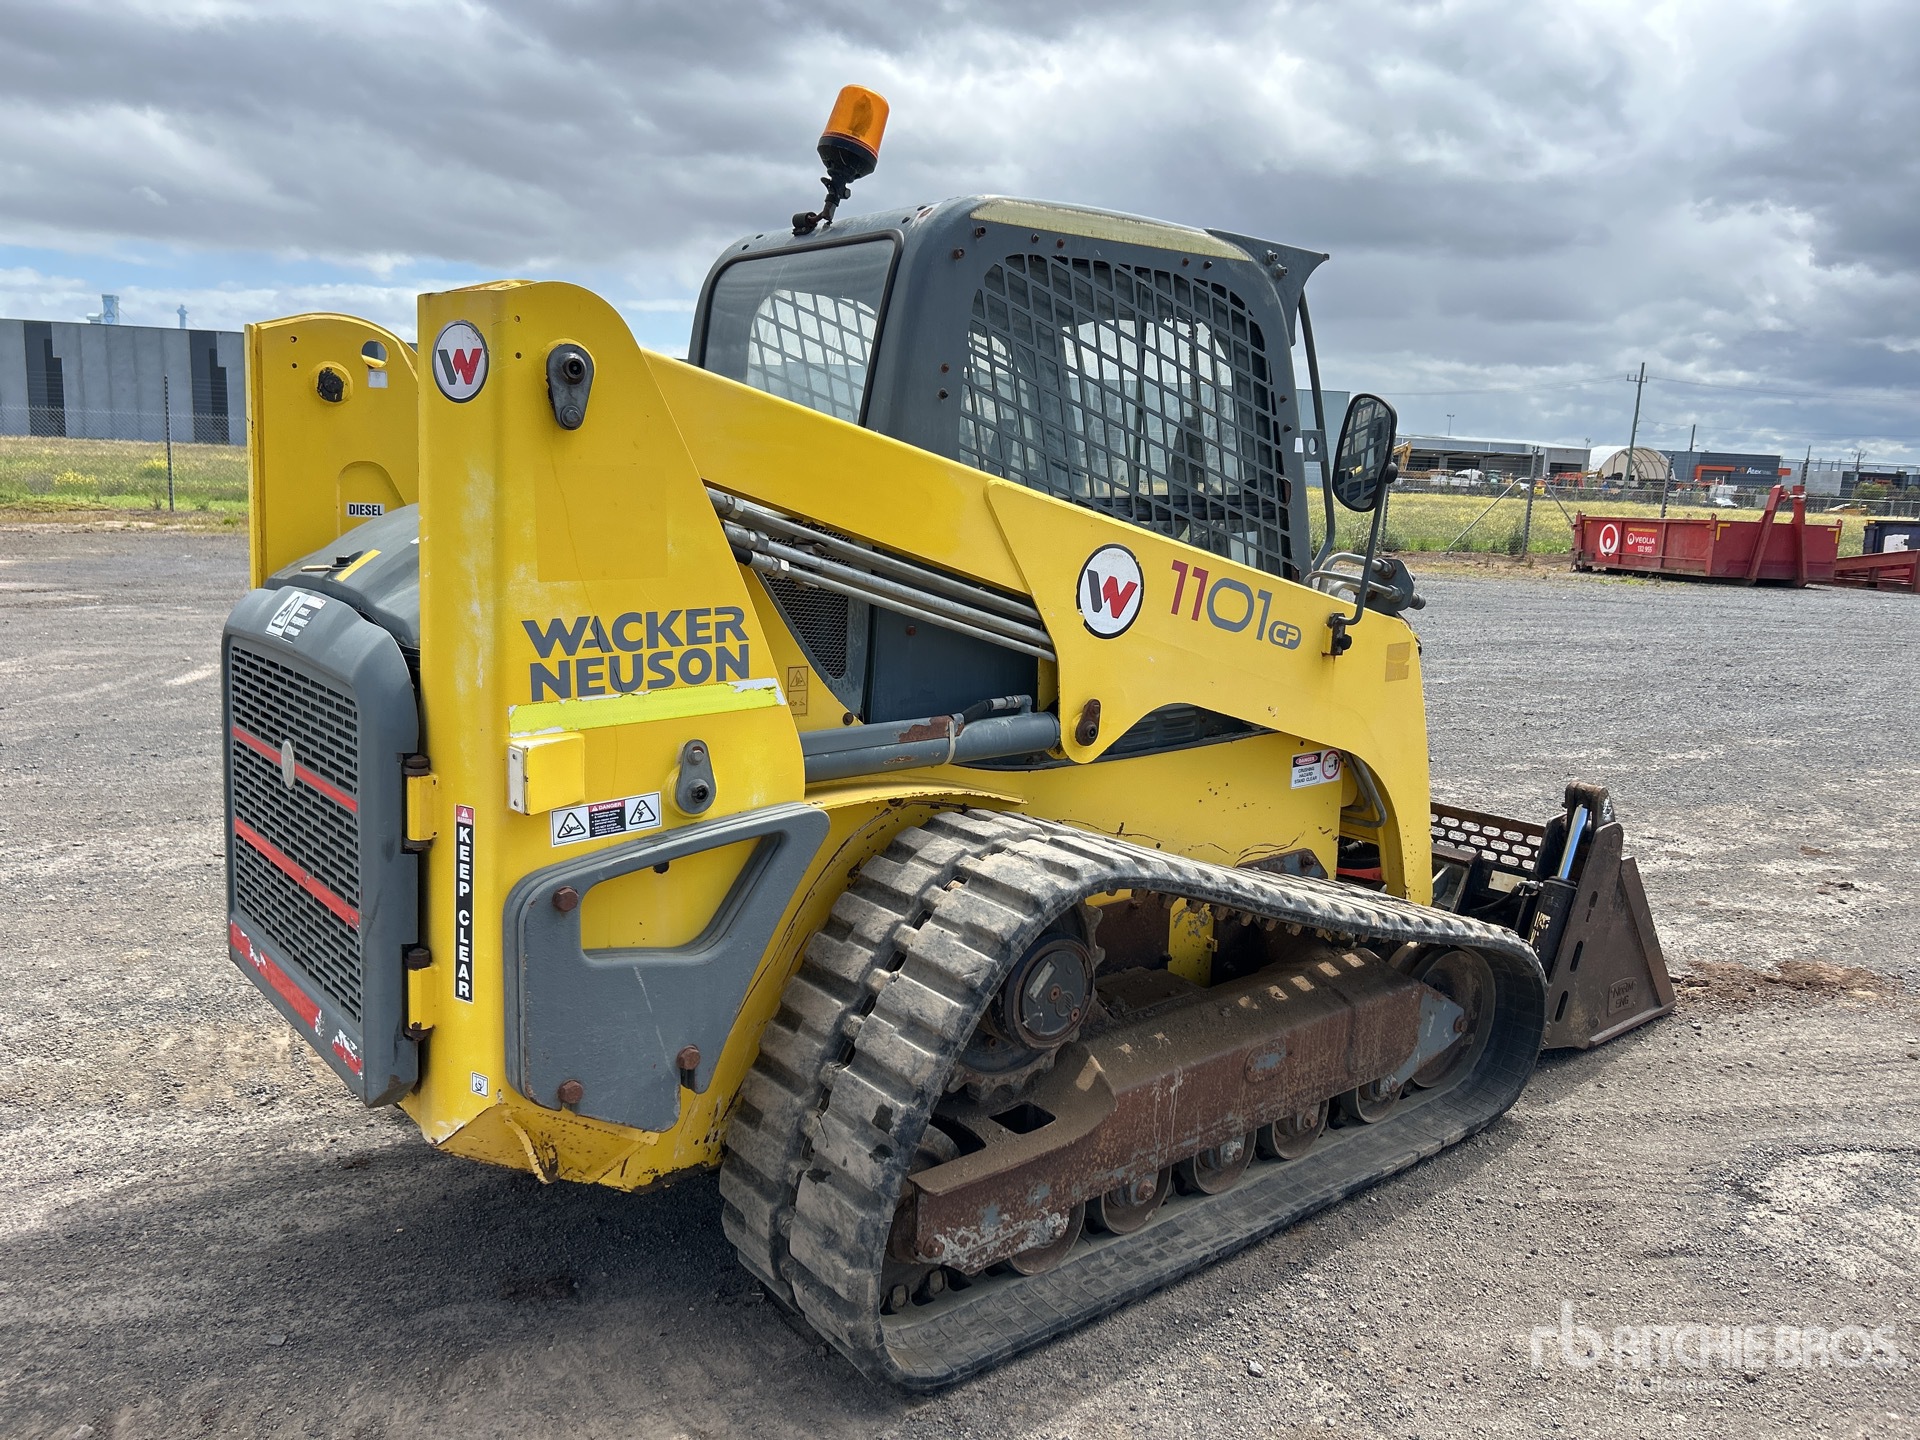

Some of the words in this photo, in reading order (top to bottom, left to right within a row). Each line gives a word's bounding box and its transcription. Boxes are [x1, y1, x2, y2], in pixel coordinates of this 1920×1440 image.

[349, 503, 383, 516] DIESEL
[1635, 536, 1656, 545] VEOLIA
[1170, 559, 1273, 642] 1101
[521, 606, 749, 659] WACKER
[530, 644, 750, 703] NEUSON
[598, 801, 622, 811] DANGER
[459, 826, 471, 897] KEEP
[458, 909, 470, 998] CLEAR
